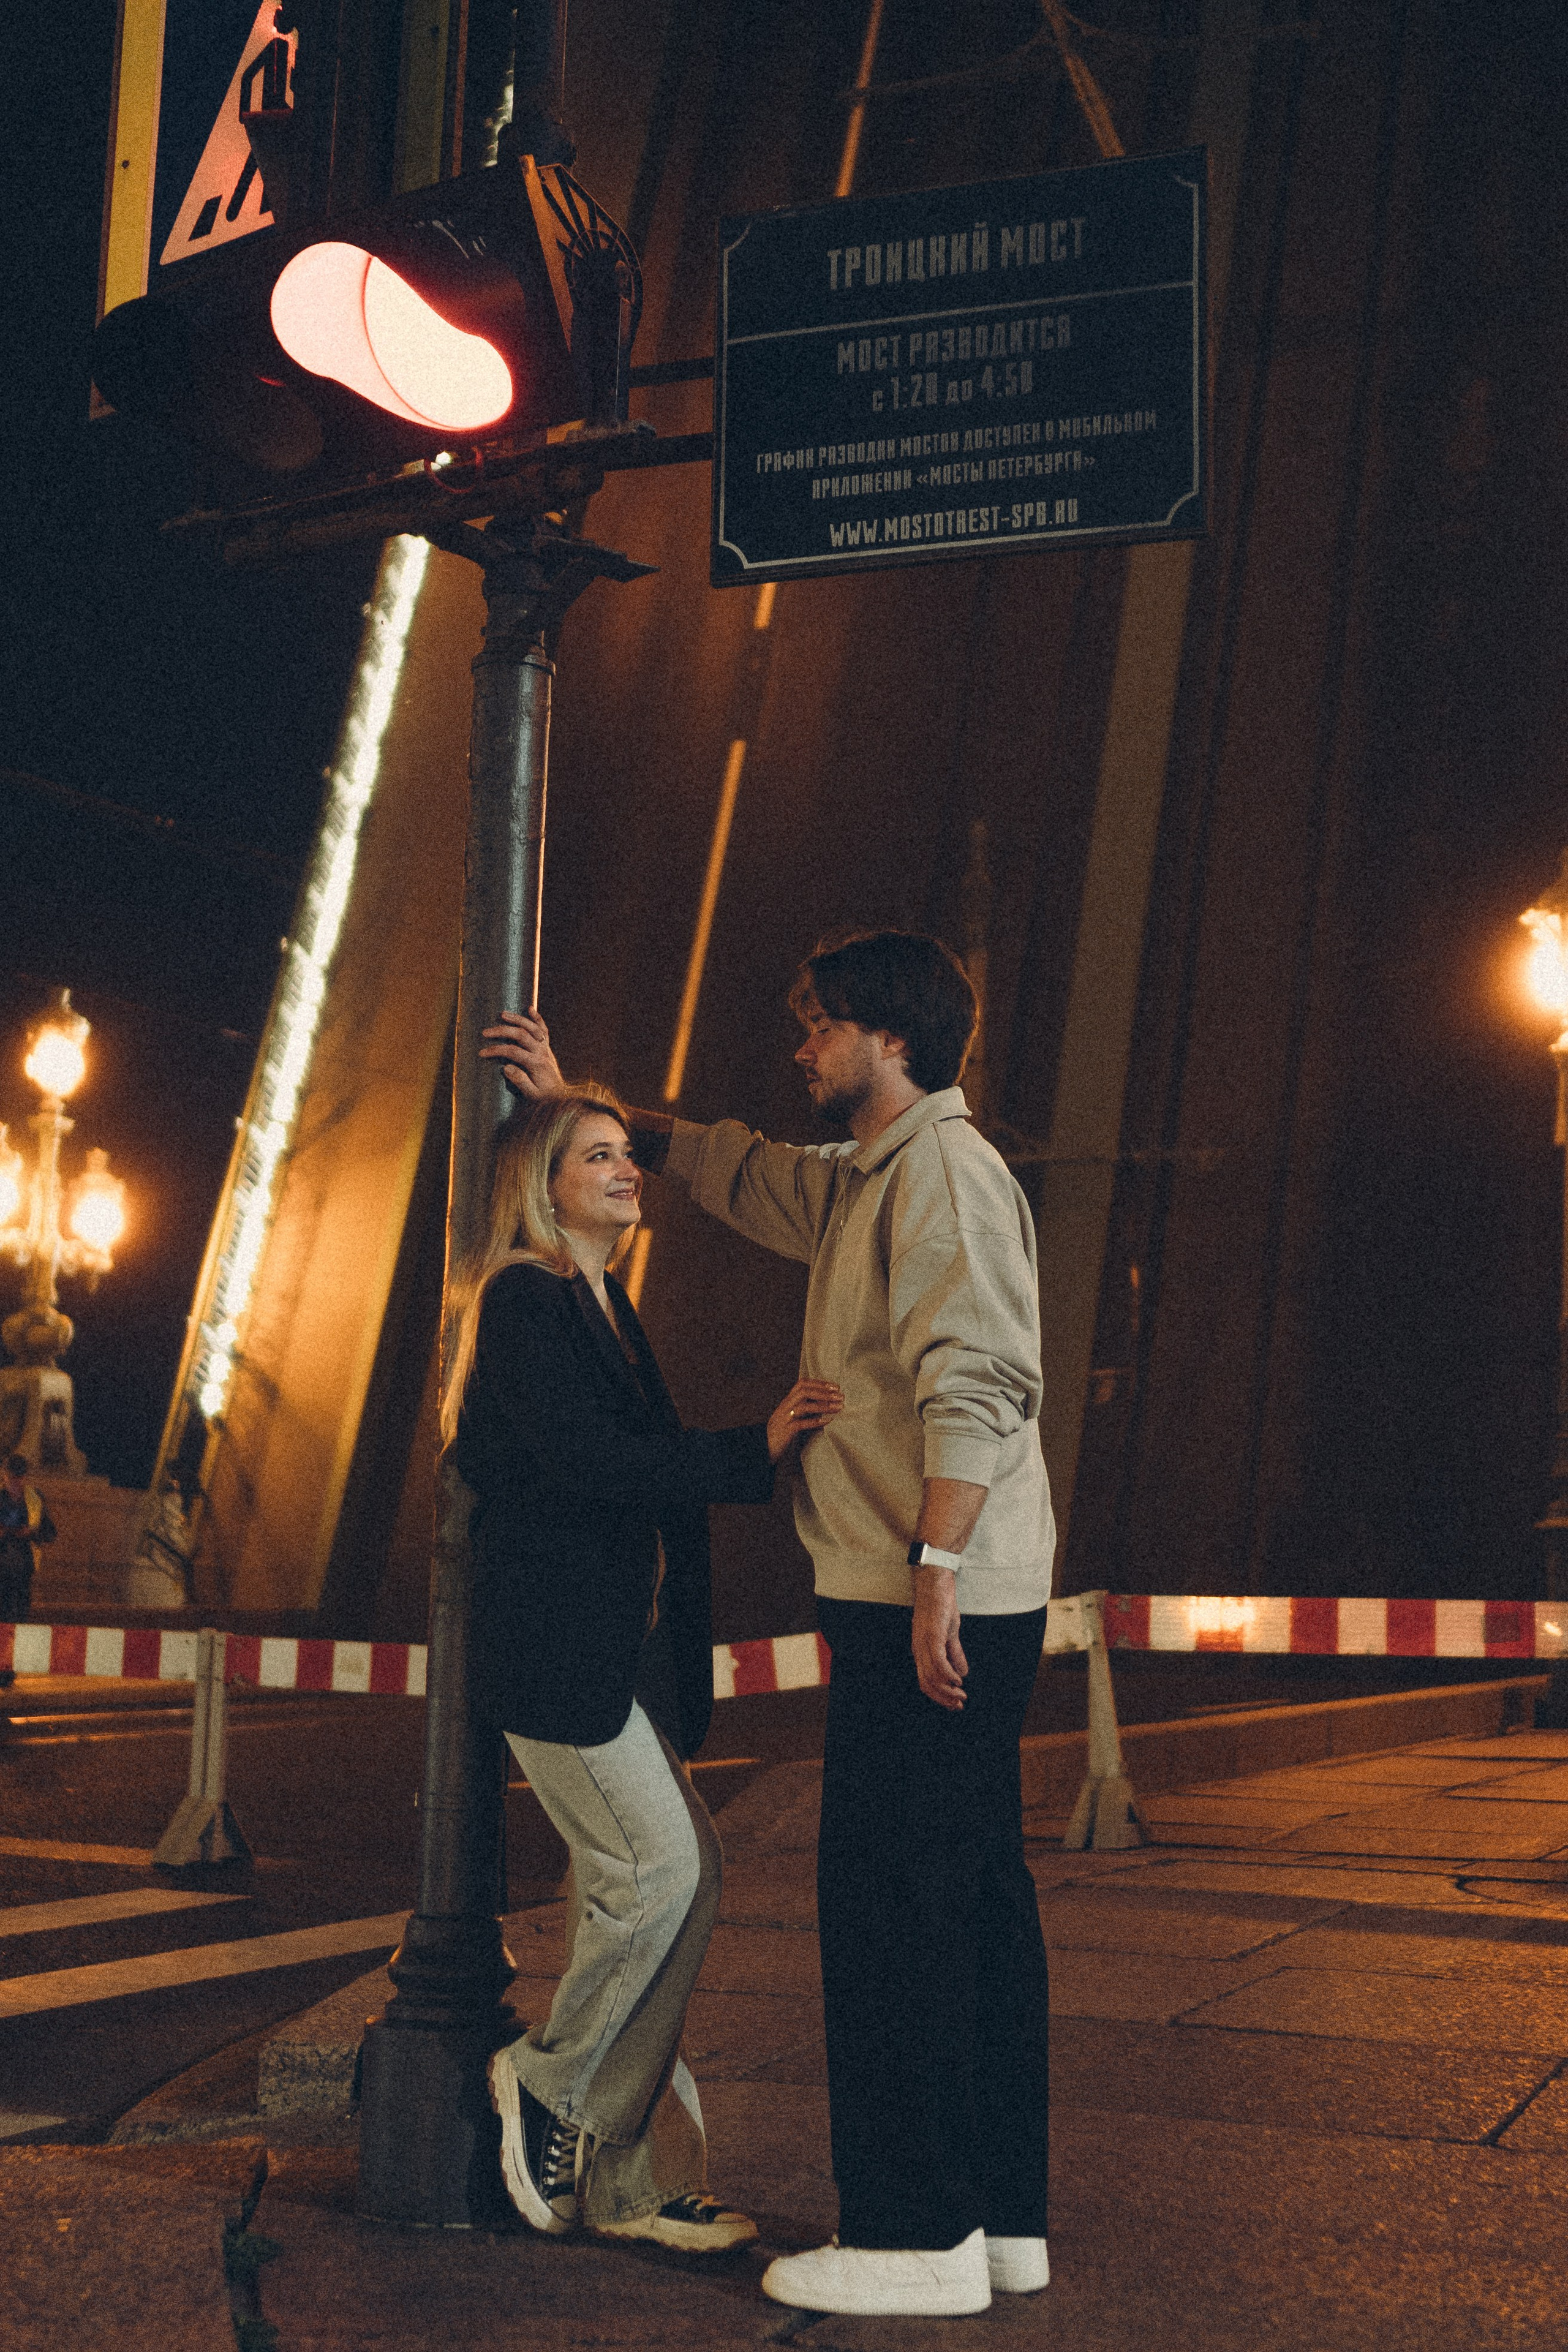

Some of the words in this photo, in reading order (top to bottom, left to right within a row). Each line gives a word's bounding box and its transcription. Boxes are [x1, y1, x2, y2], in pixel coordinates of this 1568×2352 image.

[827, 222, 989, 290] ТРОИЦКИЙ
[1001, 218, 1085, 268] МОСТ
[837, 335, 901, 374] МОСТ
[907, 314, 1070, 368] РАЗВОДИТСЯ
[872, 390, 883, 412] с
[891, 372, 938, 410] 1:20
[946, 380, 973, 404] до
[981, 361, 1033, 395] 4:50
[756, 447, 815, 473] ГРАФИК
[818, 439, 896, 467] РАЗВОДКИ
[900, 431, 959, 457] МОСТОВ
[963, 423, 1040, 451] ДОСТУПЕН
[1045, 420, 1054, 441] В
[1058, 411, 1156, 439] МОБИЛЬНОМ
[812, 469, 912, 500] ПРИЛОЖЕНИИ
[916, 461, 984, 486] «МОСТЫ
[987, 450, 1095, 480] ПЕТЕРБУРГА»
[829, 498, 1079, 548] WWW.MOSTOTREST-SPB.RU
